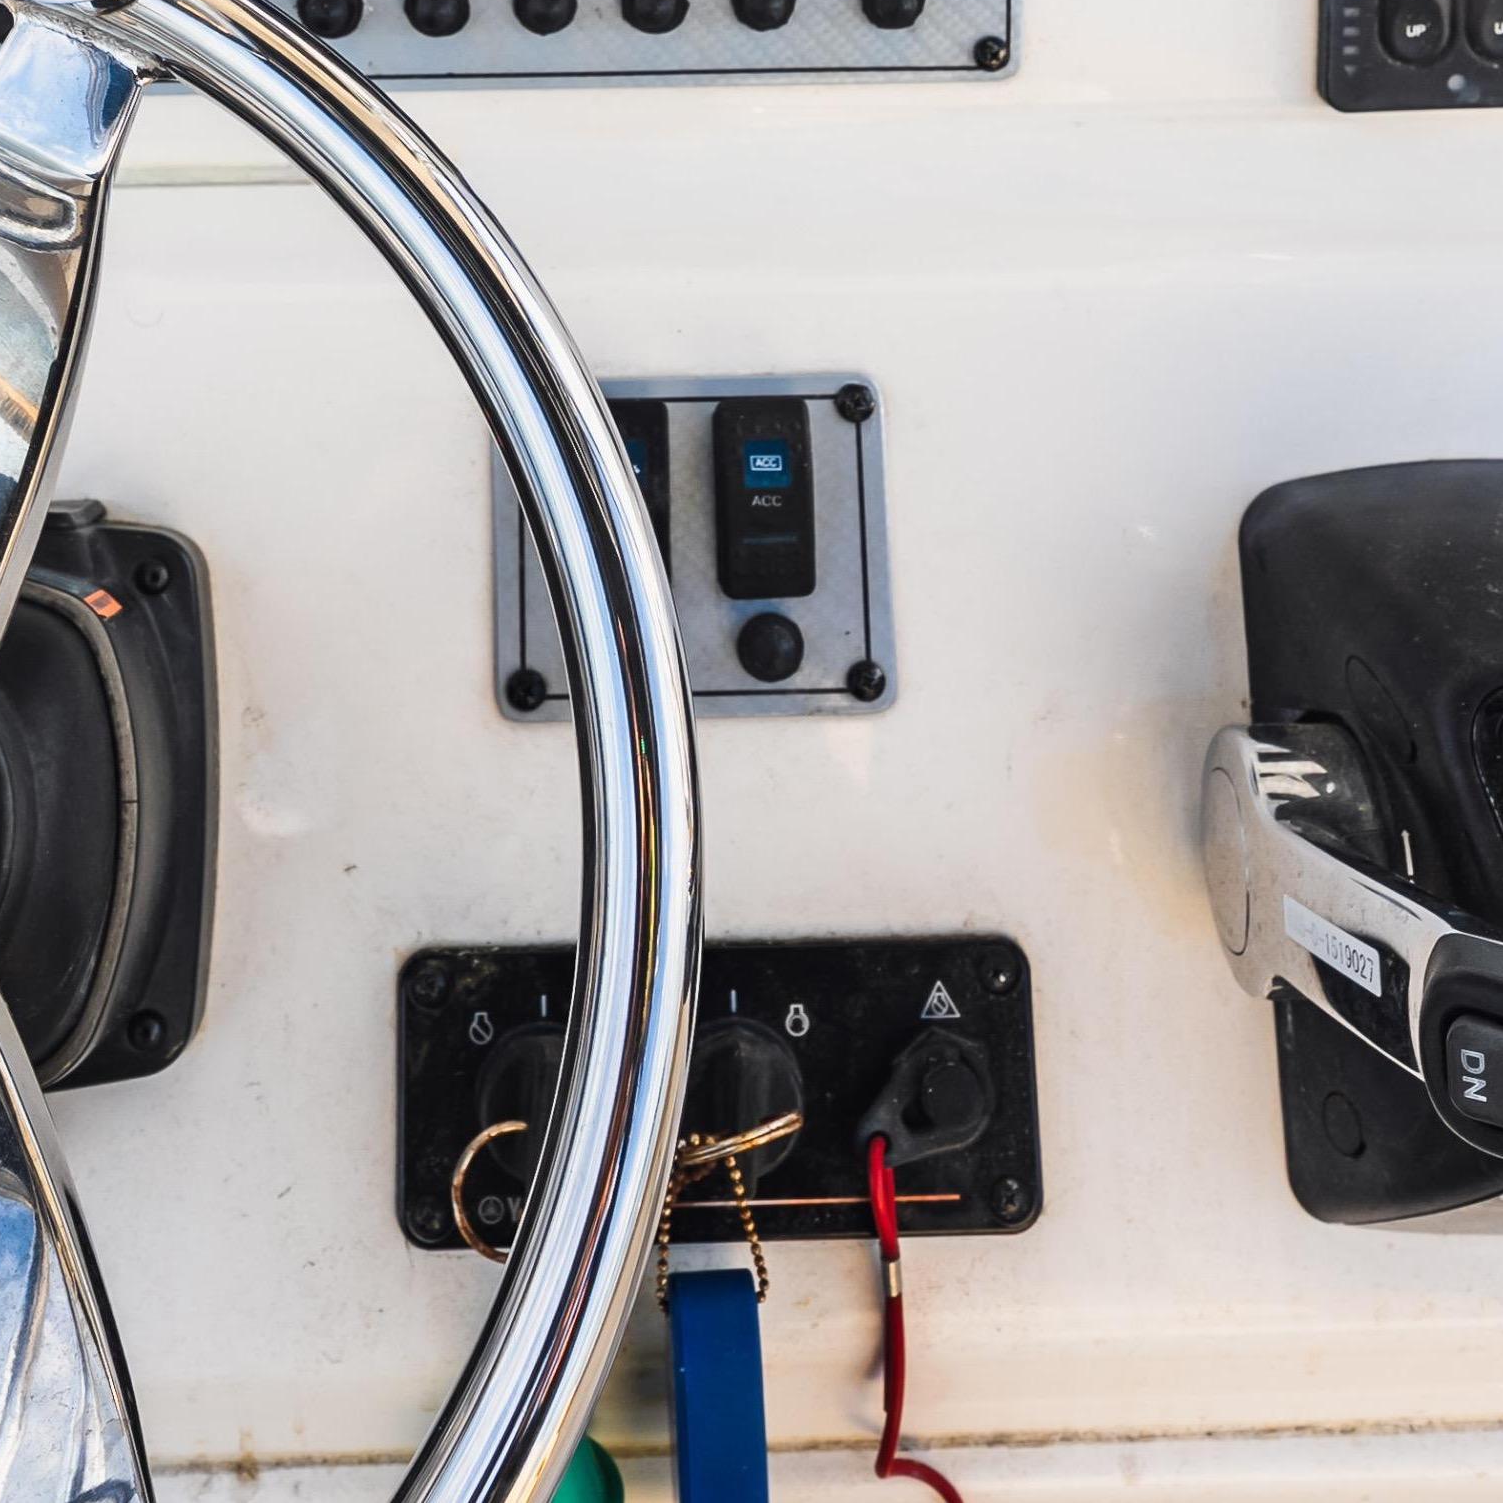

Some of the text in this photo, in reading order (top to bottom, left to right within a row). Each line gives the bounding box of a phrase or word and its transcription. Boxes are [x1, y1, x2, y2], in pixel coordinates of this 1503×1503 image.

[1405, 23, 1427, 38] UP
[751, 495, 783, 507] ACC
[1459, 1048, 1488, 1103] DN
